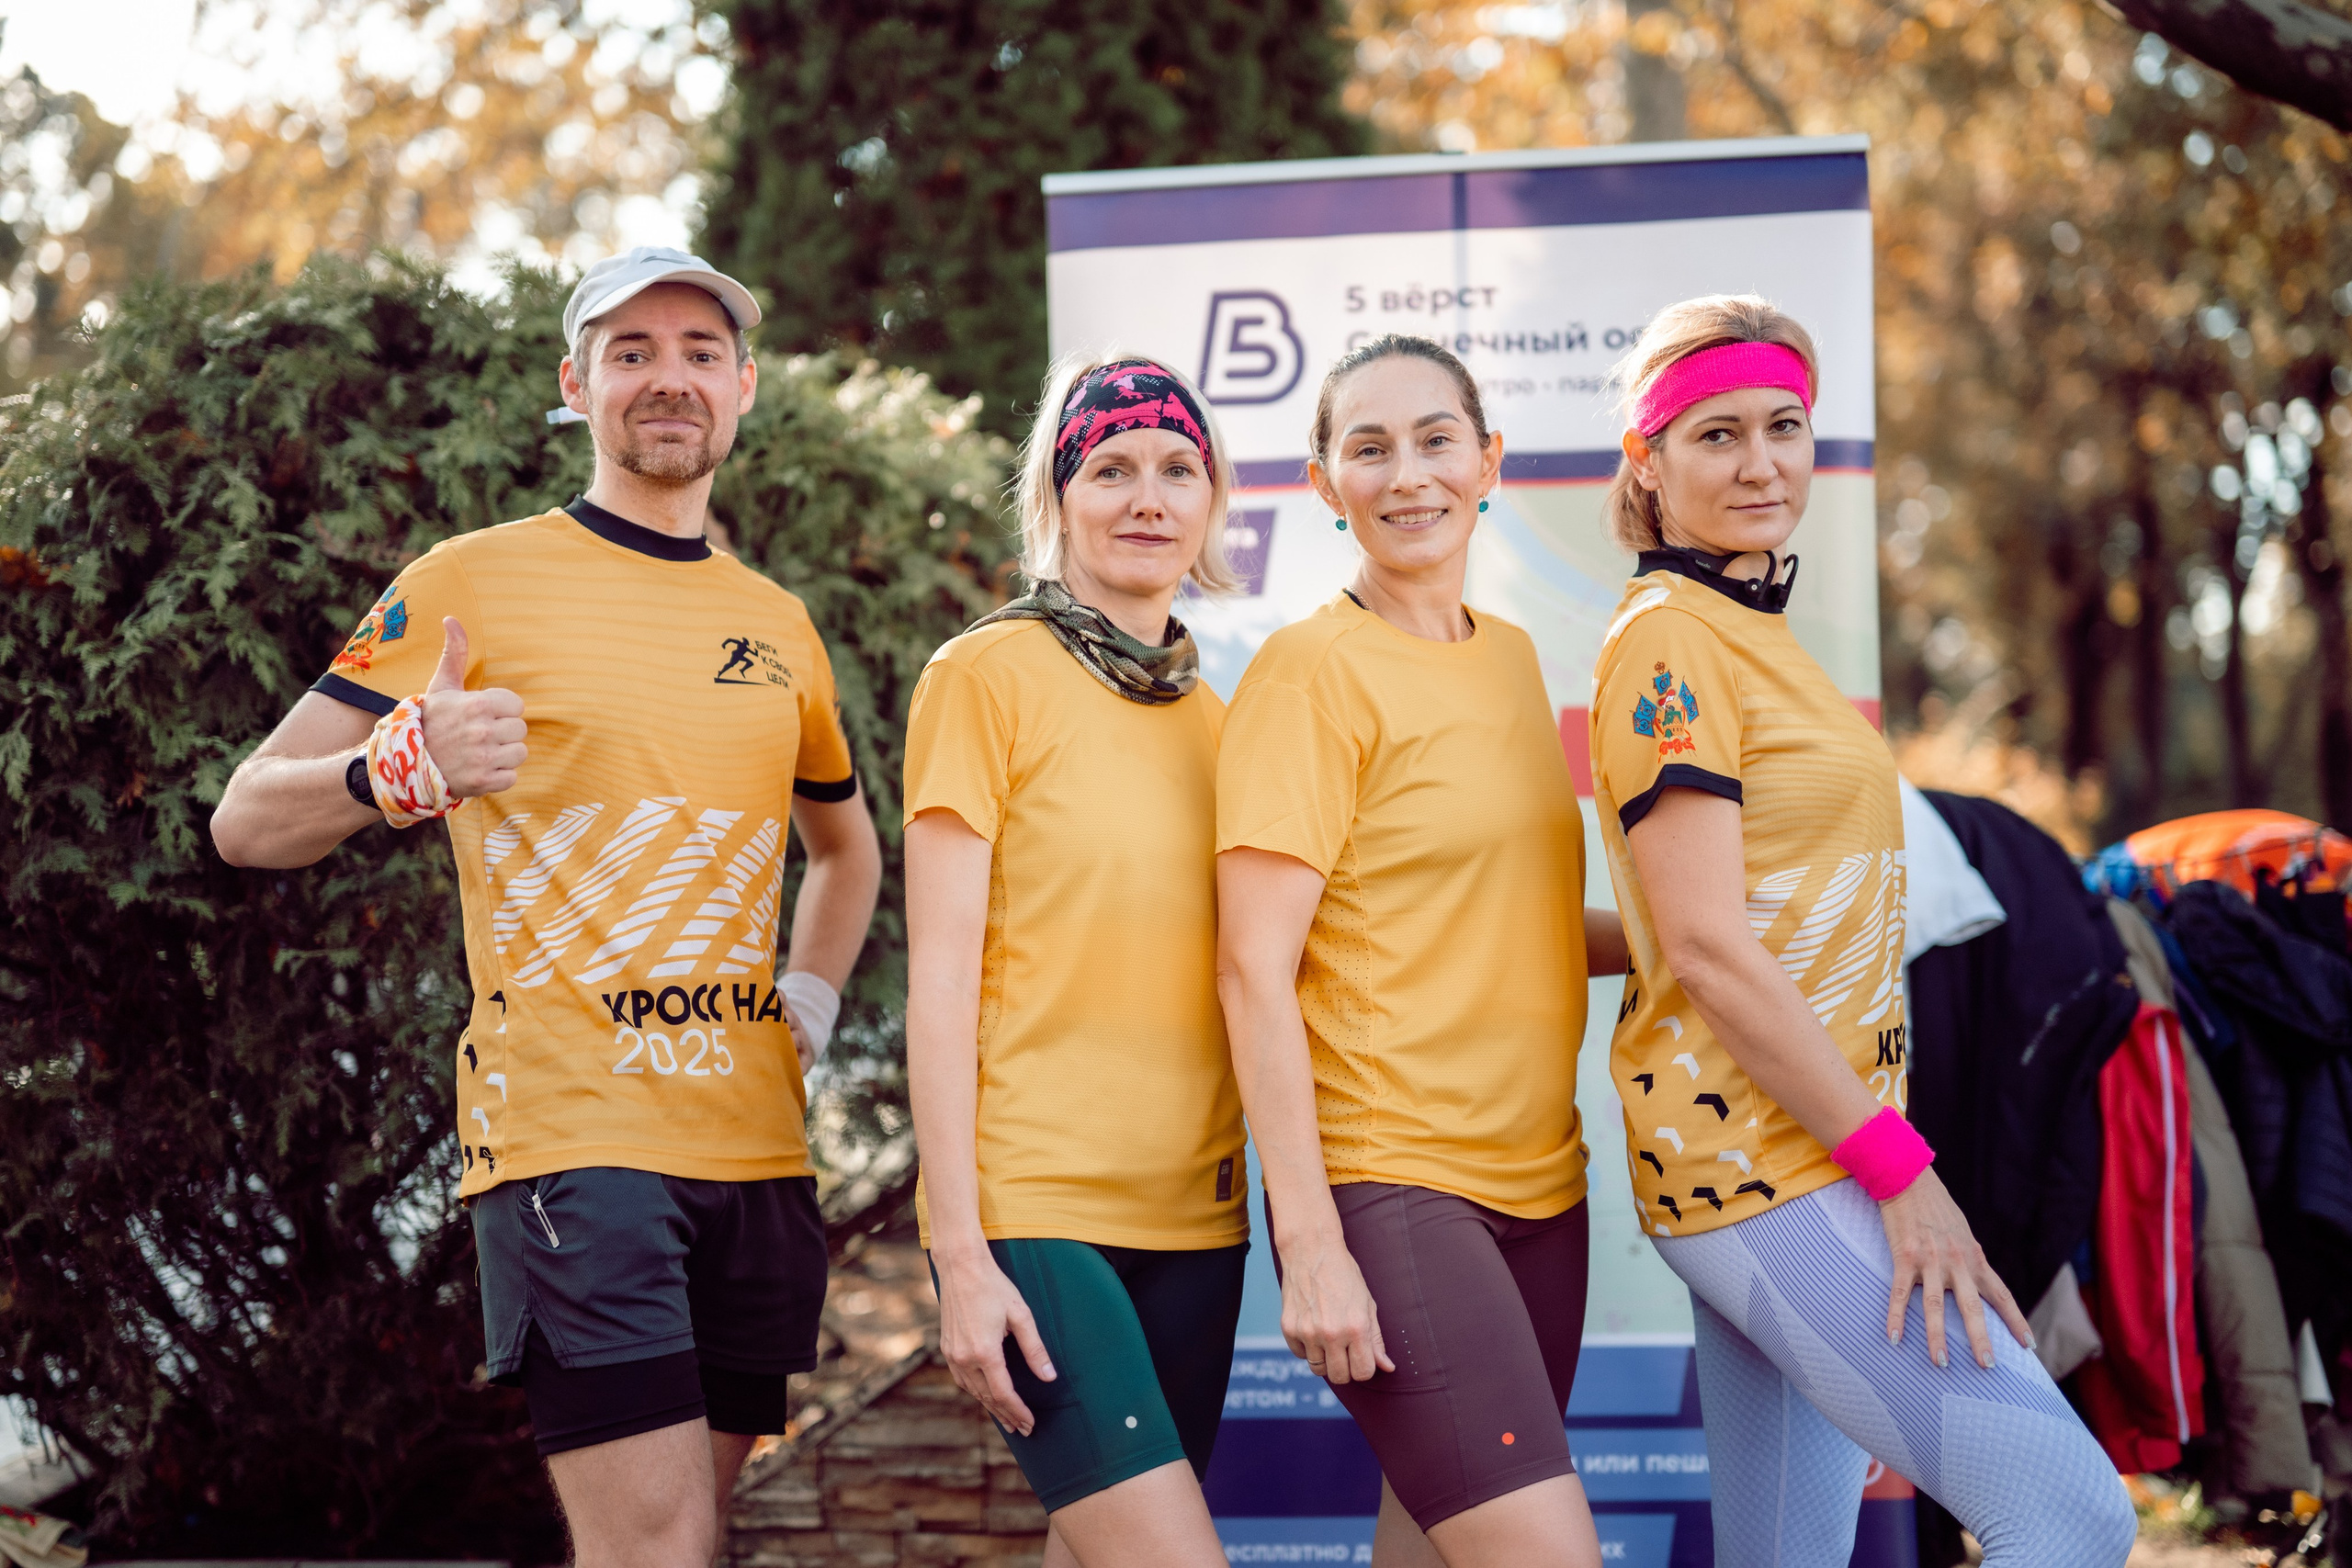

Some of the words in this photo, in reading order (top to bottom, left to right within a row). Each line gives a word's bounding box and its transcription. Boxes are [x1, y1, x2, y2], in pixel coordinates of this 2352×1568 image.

[1345, 286, 1367, 312] 5
[1382, 282, 1497, 317] вёрст
[754, 640, 778, 657] БЕГИ
[761, 655, 769, 666] К
[766, 671, 789, 690] ЦЕЛИ
[602, 983, 722, 1028] КРОСС
[732, 983, 787, 1023] НА
[612, 1026, 734, 1076] 2025
[1875, 1021, 1906, 1066] КР
[1226, 1389, 1296, 1408] етом
[1584, 1454, 1640, 1473] или
[1224, 1544, 1350, 1562] есплатно
